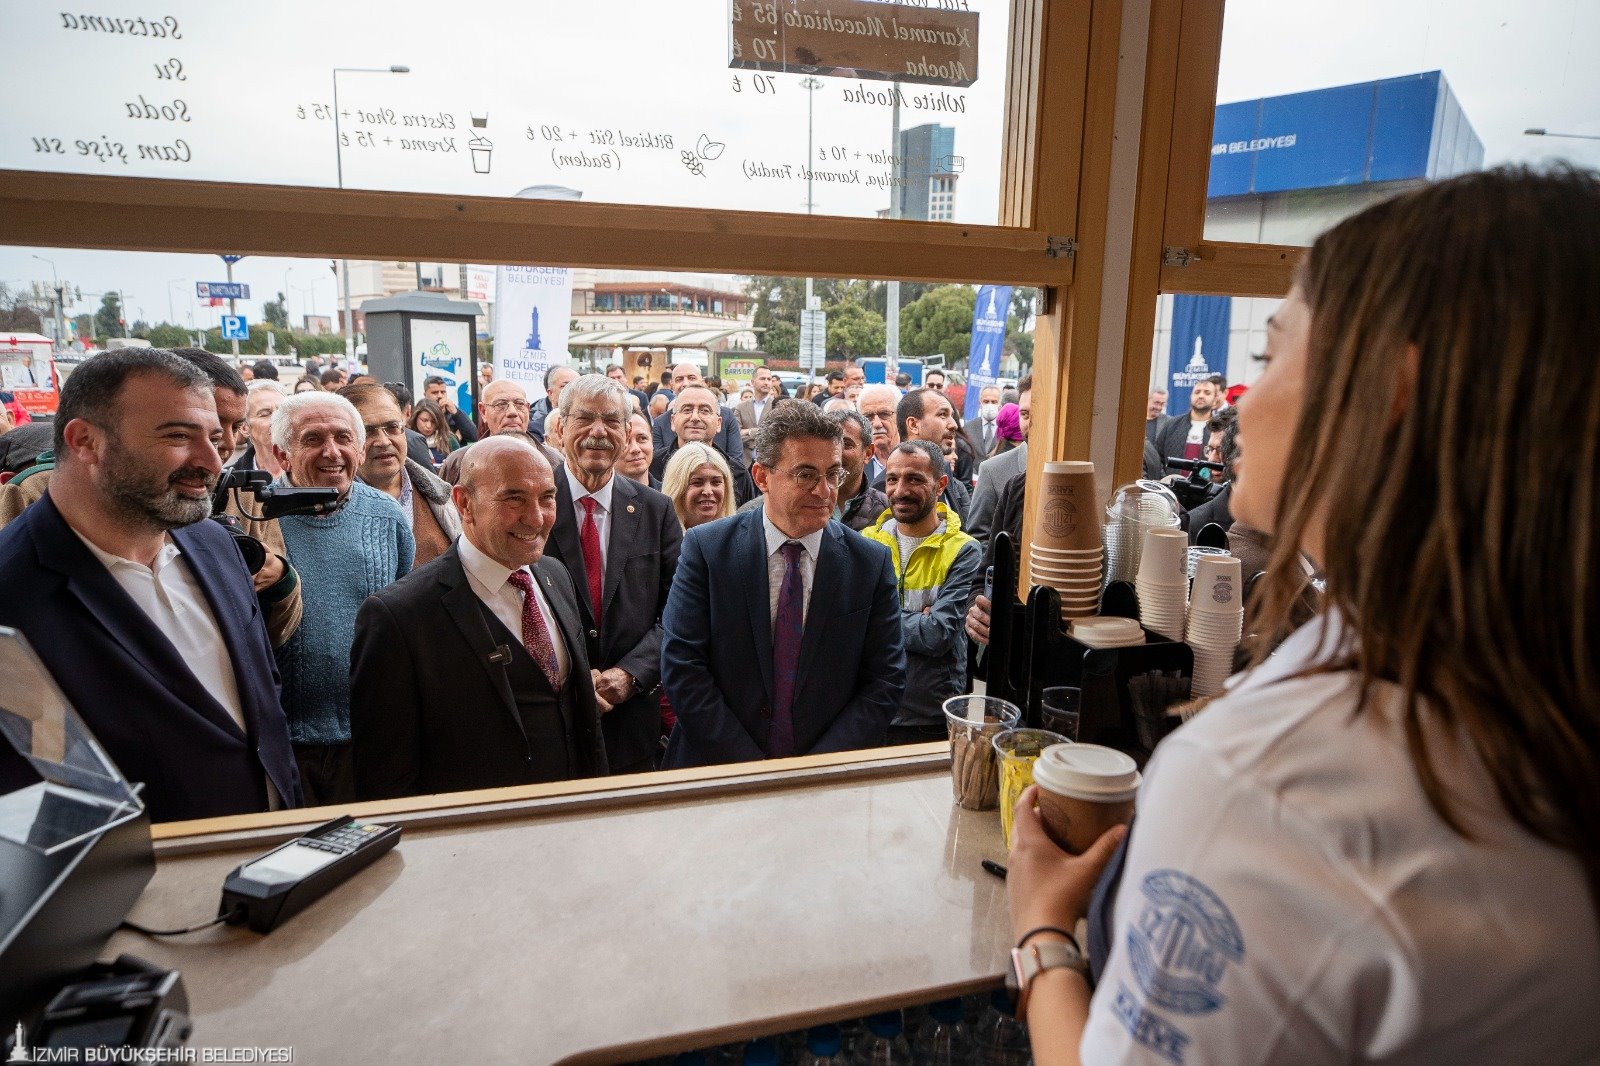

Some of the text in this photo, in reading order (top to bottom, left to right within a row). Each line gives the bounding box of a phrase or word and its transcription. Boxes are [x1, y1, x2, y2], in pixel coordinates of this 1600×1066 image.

[508, 273, 565, 286] BELEDİYESİ
[224, 316, 240, 337] P
[519, 349, 547, 361] İZMİR
[505, 371, 545, 382] BELEDİY
